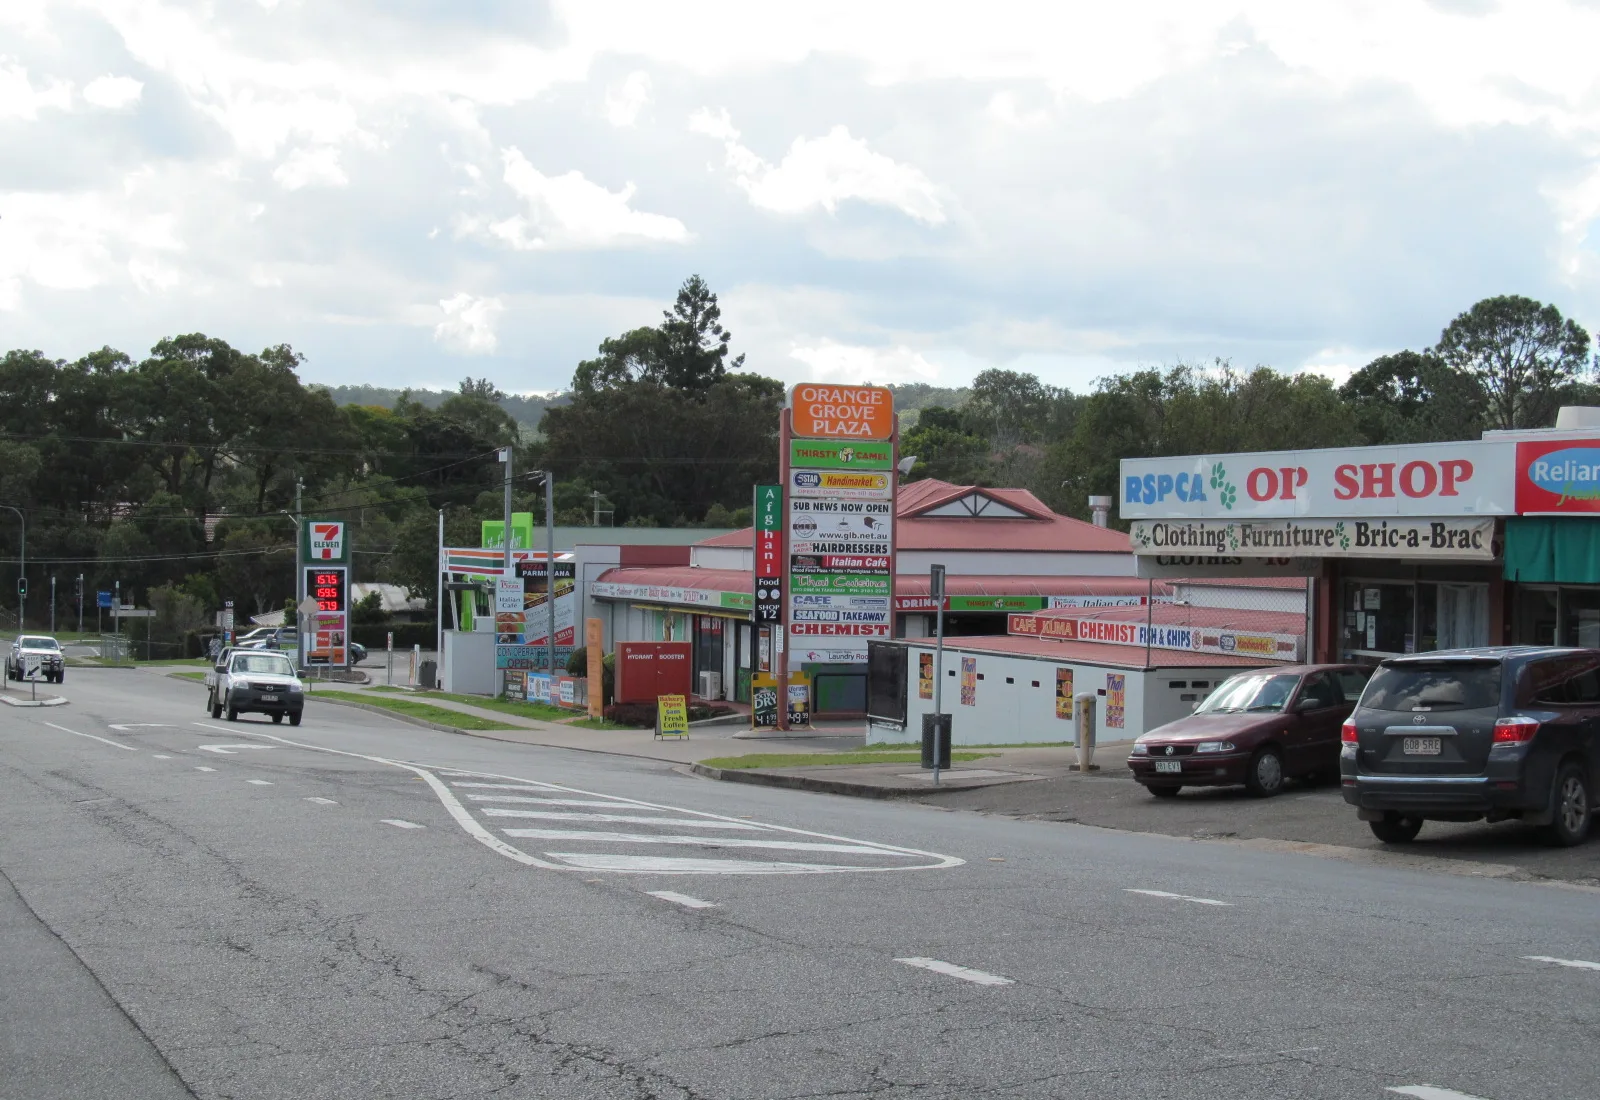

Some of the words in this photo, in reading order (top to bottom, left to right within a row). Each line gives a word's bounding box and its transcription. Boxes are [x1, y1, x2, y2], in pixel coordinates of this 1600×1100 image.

[801, 388, 882, 405] ORANGE
[809, 403, 875, 420] GROVE
[813, 420, 872, 435] PLAZA
[796, 449, 837, 458] THIRSTY
[856, 451, 888, 460] CAMEL
[827, 476, 873, 487] Handimarket
[1247, 467, 1308, 501] OP
[1334, 459, 1474, 500] SHOP
[1126, 472, 1207, 505] RSPCA
[793, 502, 810, 511] SUB
[813, 502, 838, 511] NEWS
[841, 503, 863, 512] NOW
[866, 504, 889, 513] OPEN
[764, 489, 774, 574] Afghani
[1152, 523, 1226, 552] Clothing
[1240, 522, 1335, 547] Furniture
[1355, 521, 1482, 549] Bric-a-Brac
[813, 543, 887, 554] HAIRDRESSERS
[831, 557, 862, 567] Italian
[865, 558, 887, 567] Café
[794, 575, 828, 587] Thai
[833, 576, 887, 587] Cuisine
[793, 596, 831, 604] CAFE
[762, 610, 777, 619] 12
[796, 611, 838, 620] SEAFOOD
[842, 612, 886, 621] TAKEAWAY
[791, 623, 889, 635] CHEMIST
[1013, 617, 1037, 633] CAFÉ
[1080, 621, 1136, 642] CHEMIST
[1167, 629, 1191, 647] CHIPS
[828, 653, 855, 661] Laundry
[754, 697, 776, 709] DRY
[1405, 740, 1420, 750] 608
